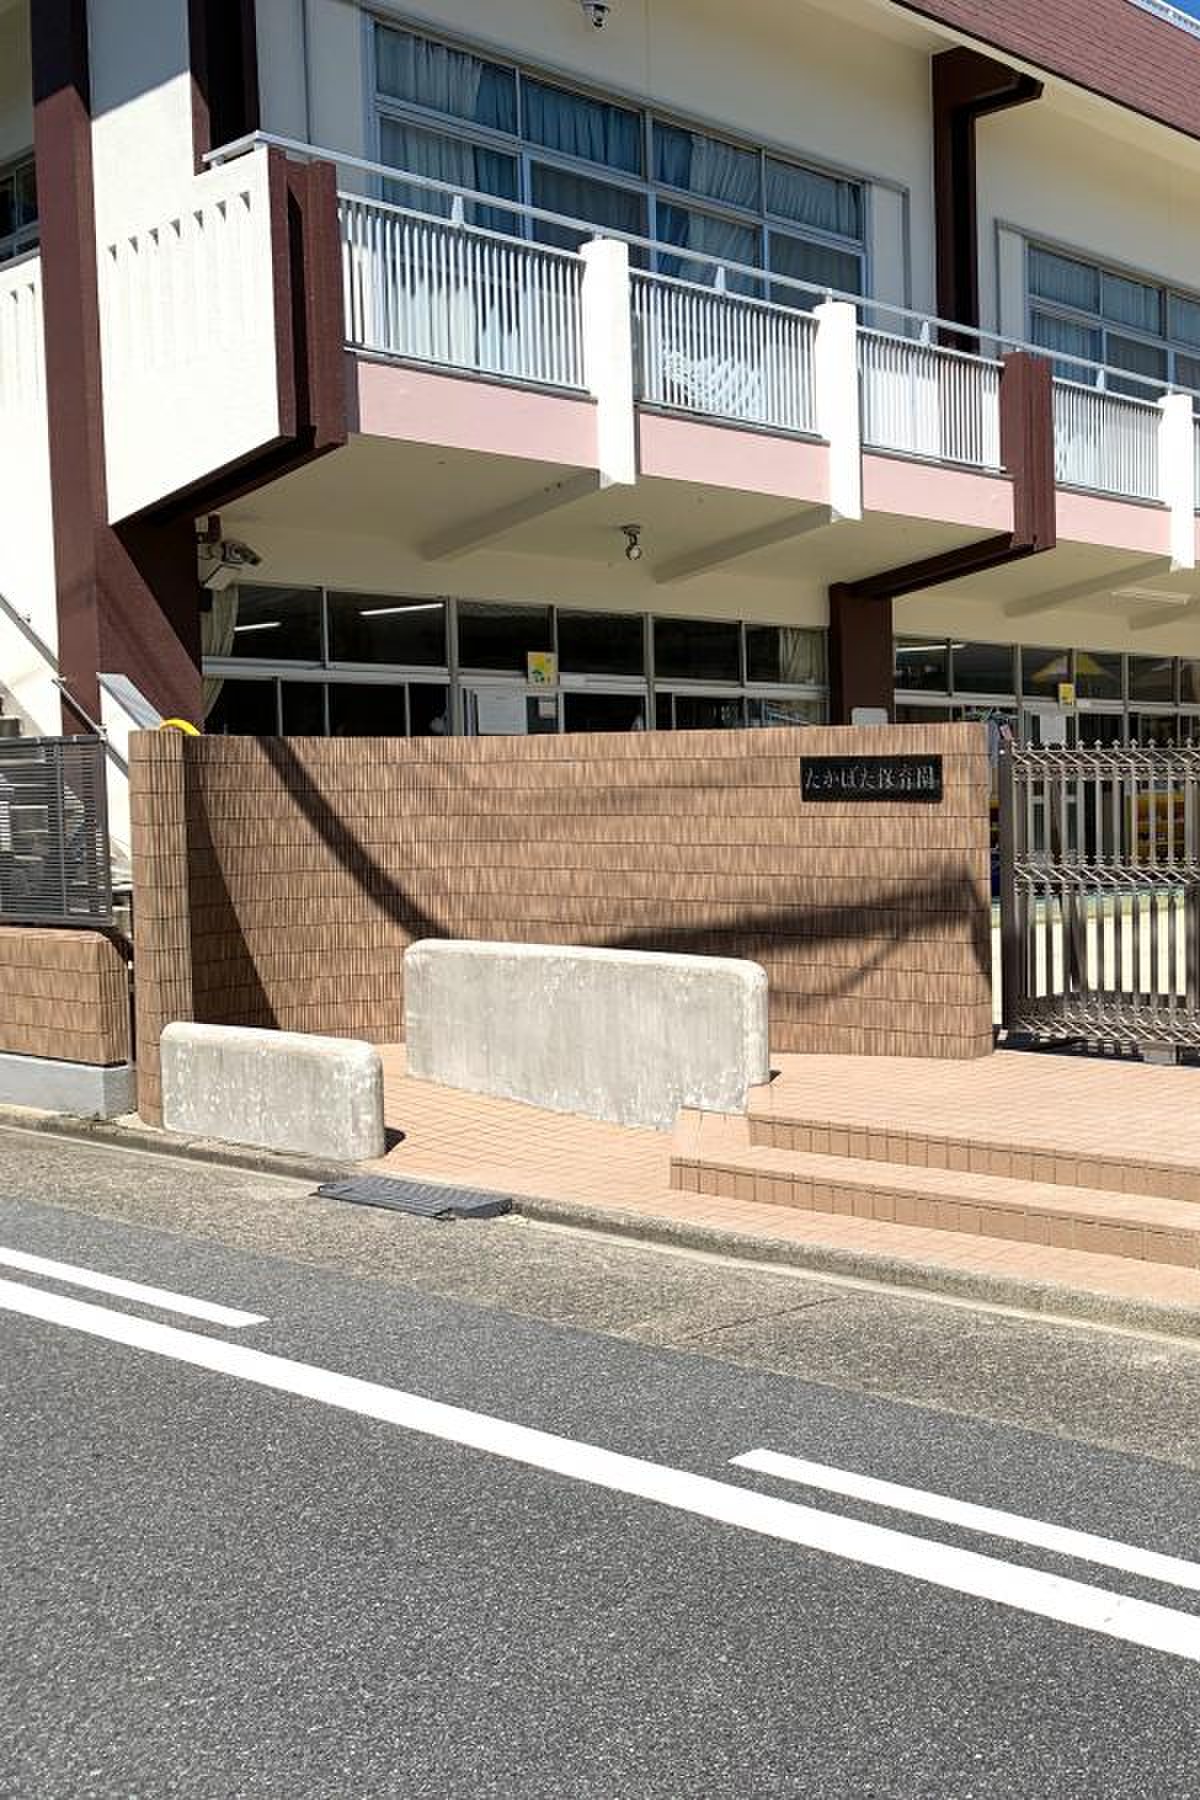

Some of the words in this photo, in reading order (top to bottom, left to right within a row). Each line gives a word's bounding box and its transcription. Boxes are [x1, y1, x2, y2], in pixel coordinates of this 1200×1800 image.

[805, 763, 935, 790] たかばた保育園
